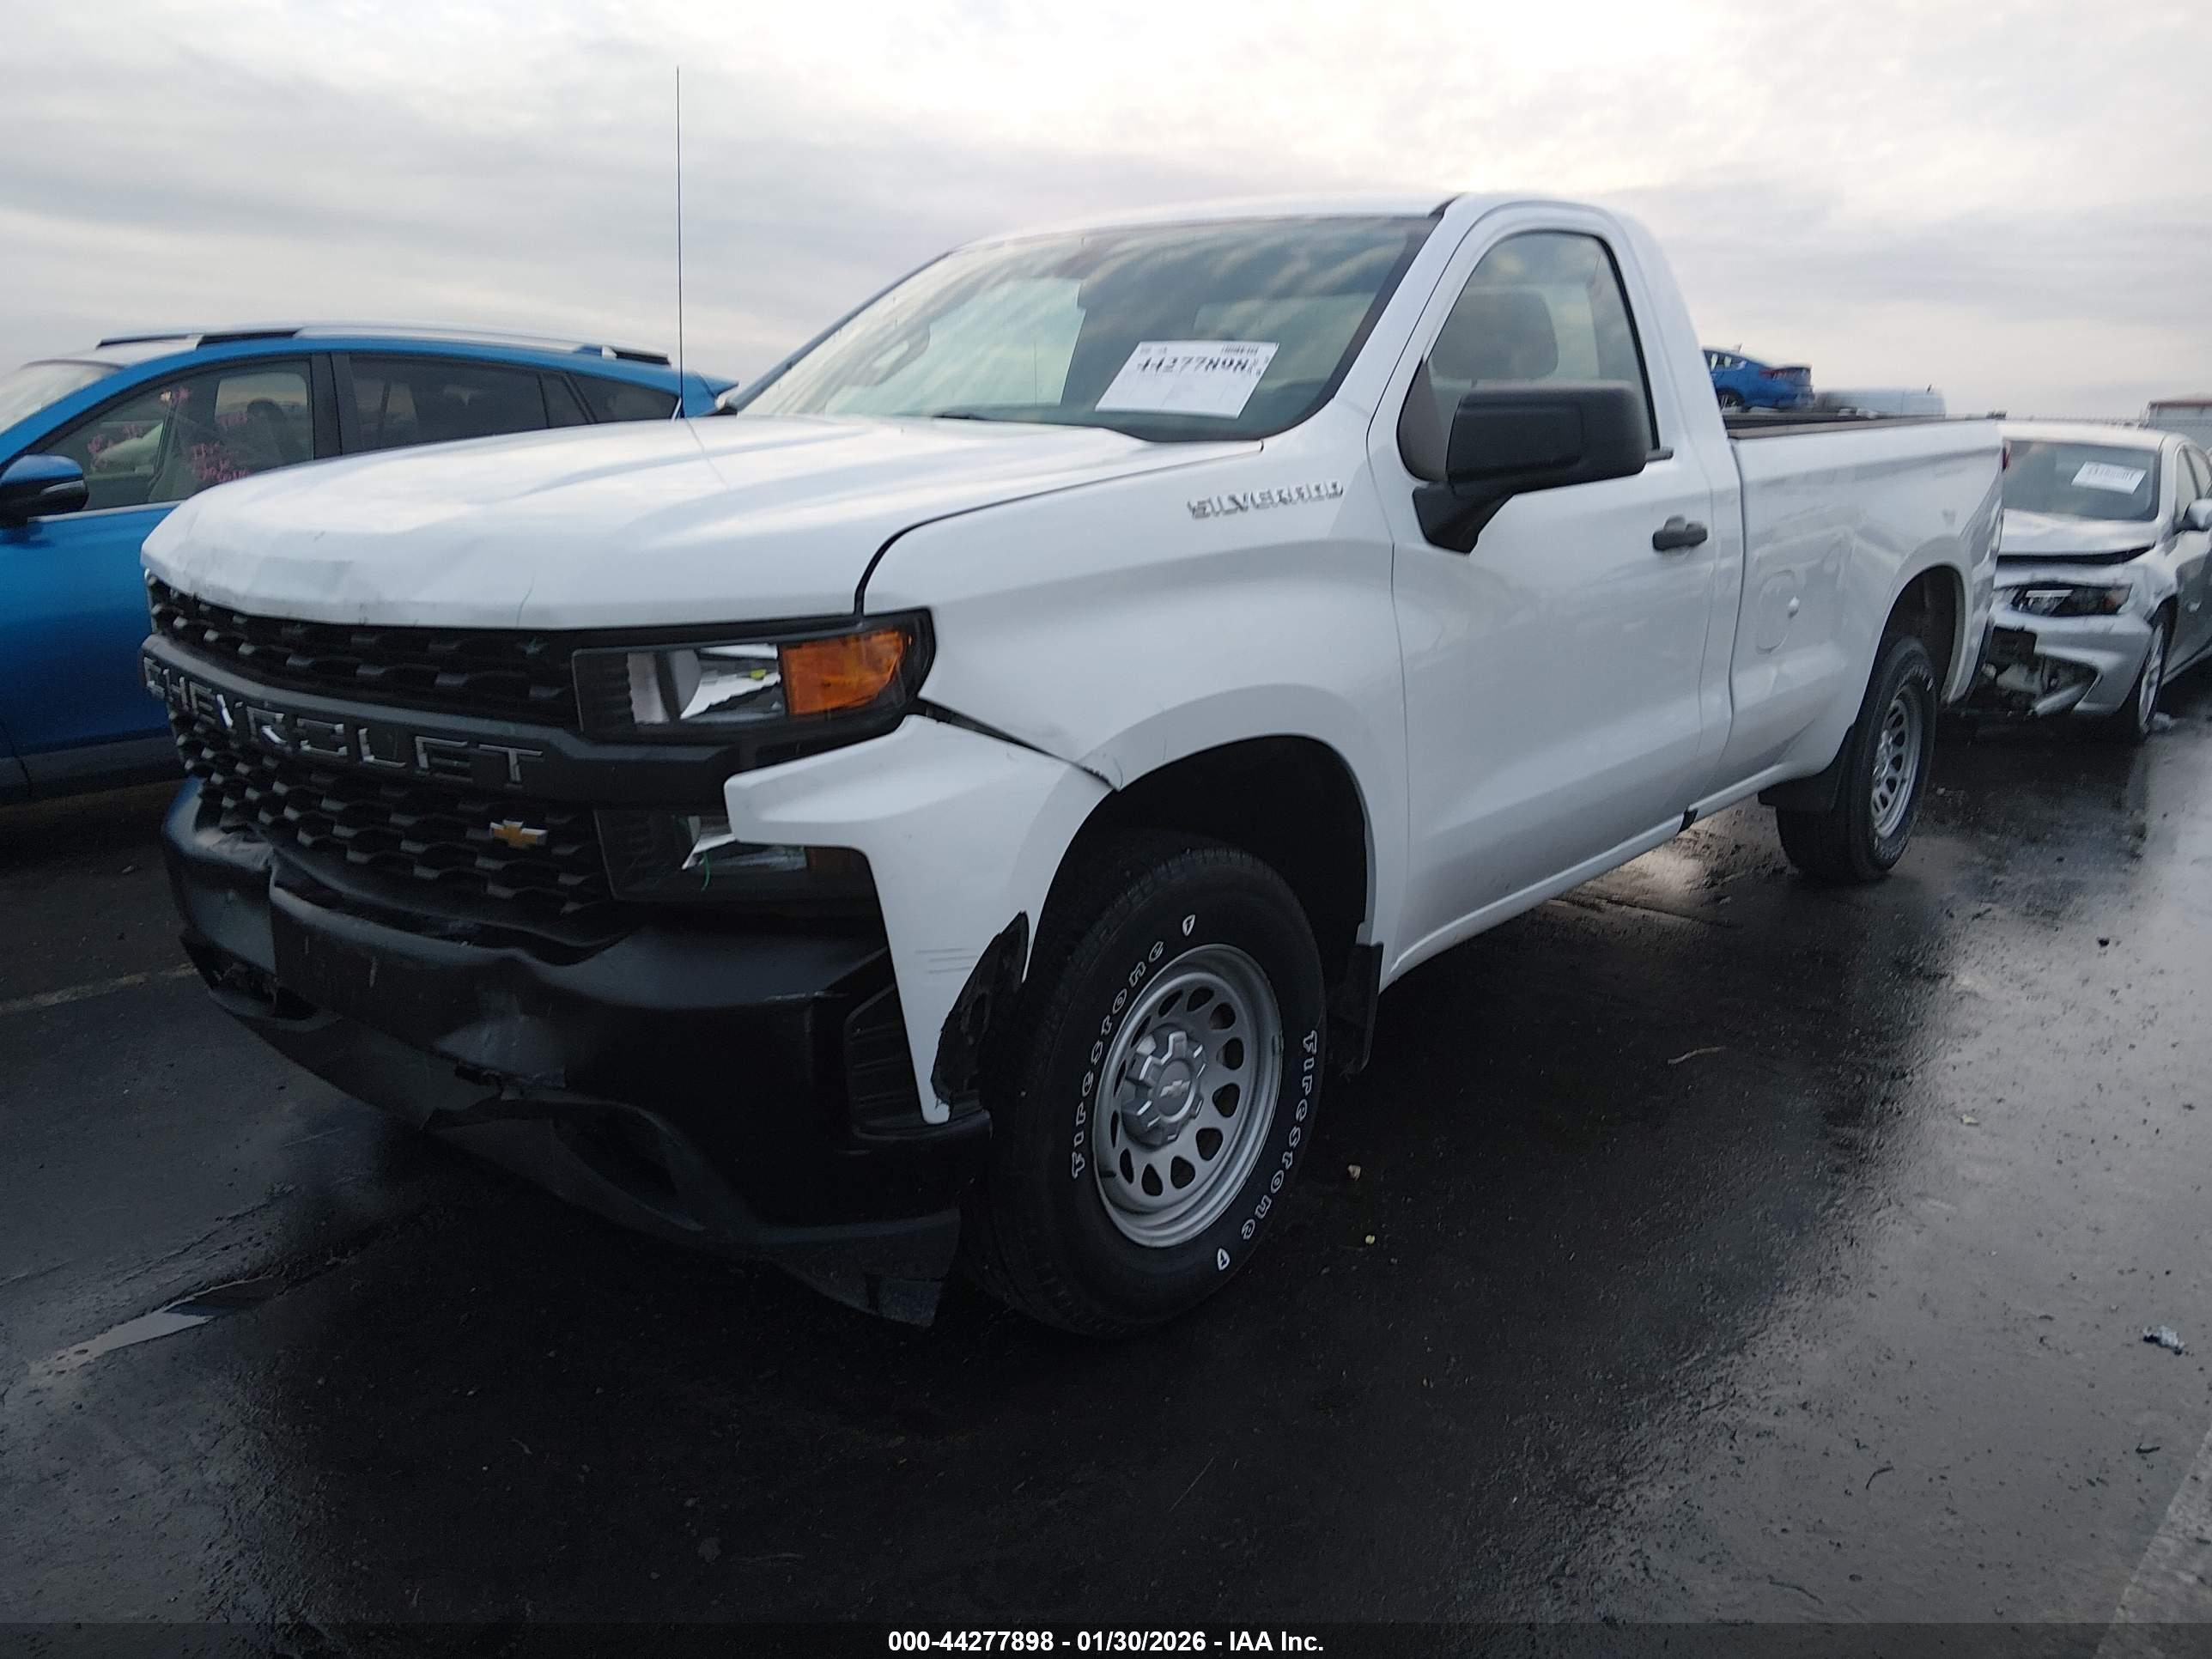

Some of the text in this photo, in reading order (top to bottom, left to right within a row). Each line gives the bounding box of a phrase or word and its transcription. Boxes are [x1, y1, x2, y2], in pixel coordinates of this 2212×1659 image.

[1187, 481, 1344, 519] SILVERADO
[144, 656, 543, 788] CHEVROLET
[1072, 941, 1164, 1179] Firestone
[1242, 1030, 1319, 1240] Firestone
